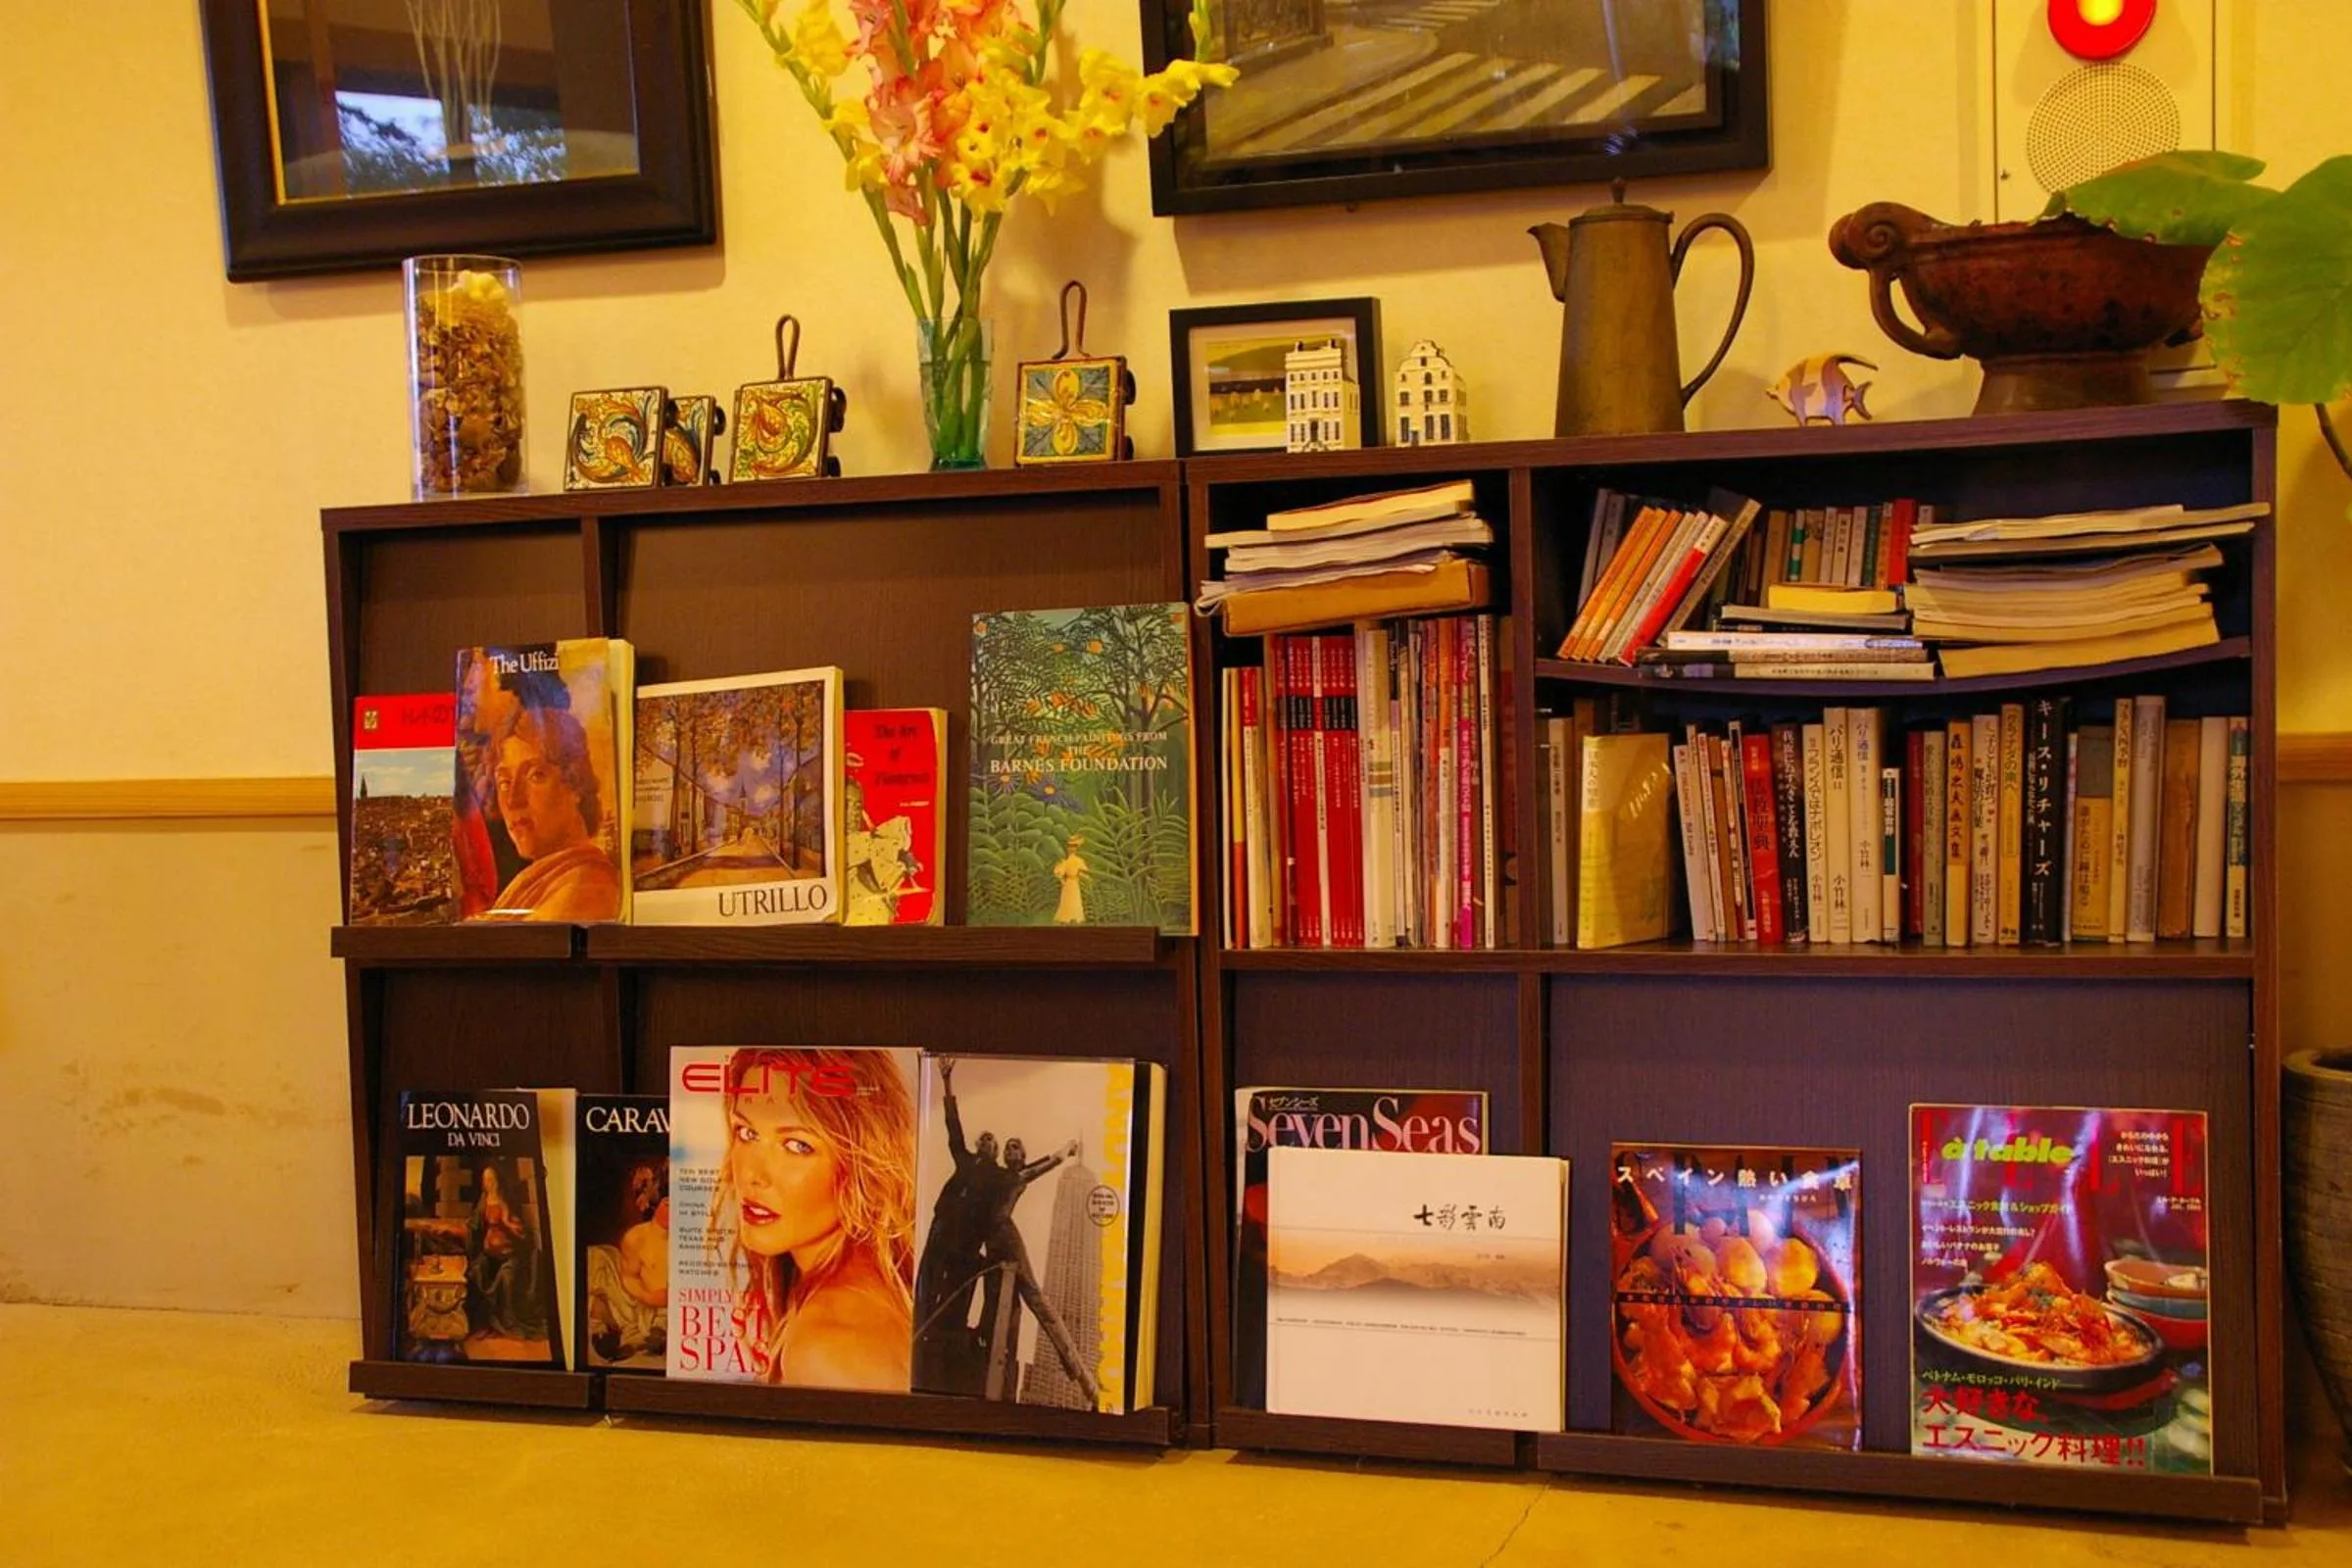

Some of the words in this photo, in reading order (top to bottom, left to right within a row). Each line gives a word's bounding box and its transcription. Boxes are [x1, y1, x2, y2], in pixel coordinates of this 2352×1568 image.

[490, 653, 518, 675] The
[519, 650, 560, 673] Uffizi
[990, 734, 1026, 745] GREAT
[1135, 731, 1168, 742] FROM
[1065, 745, 1089, 756] THE
[990, 759, 1054, 773] BARNES
[1060, 756, 1168, 772] FOUNDATION
[2034, 700, 2053, 876] キース・リチャーズ
[718, 885, 827, 918] UTRILLO
[681, 1062, 857, 1098] ELITE
[407, 1102, 530, 1130] LEONARDO
[447, 1132, 466, 1148] DA
[469, 1132, 501, 1148] VINCI
[1973, 1137, 2076, 1166] table
[678, 1288, 734, 1303] SIMPLY
[680, 1304, 769, 1341] BEST
[678, 1337, 770, 1374] SPAS
